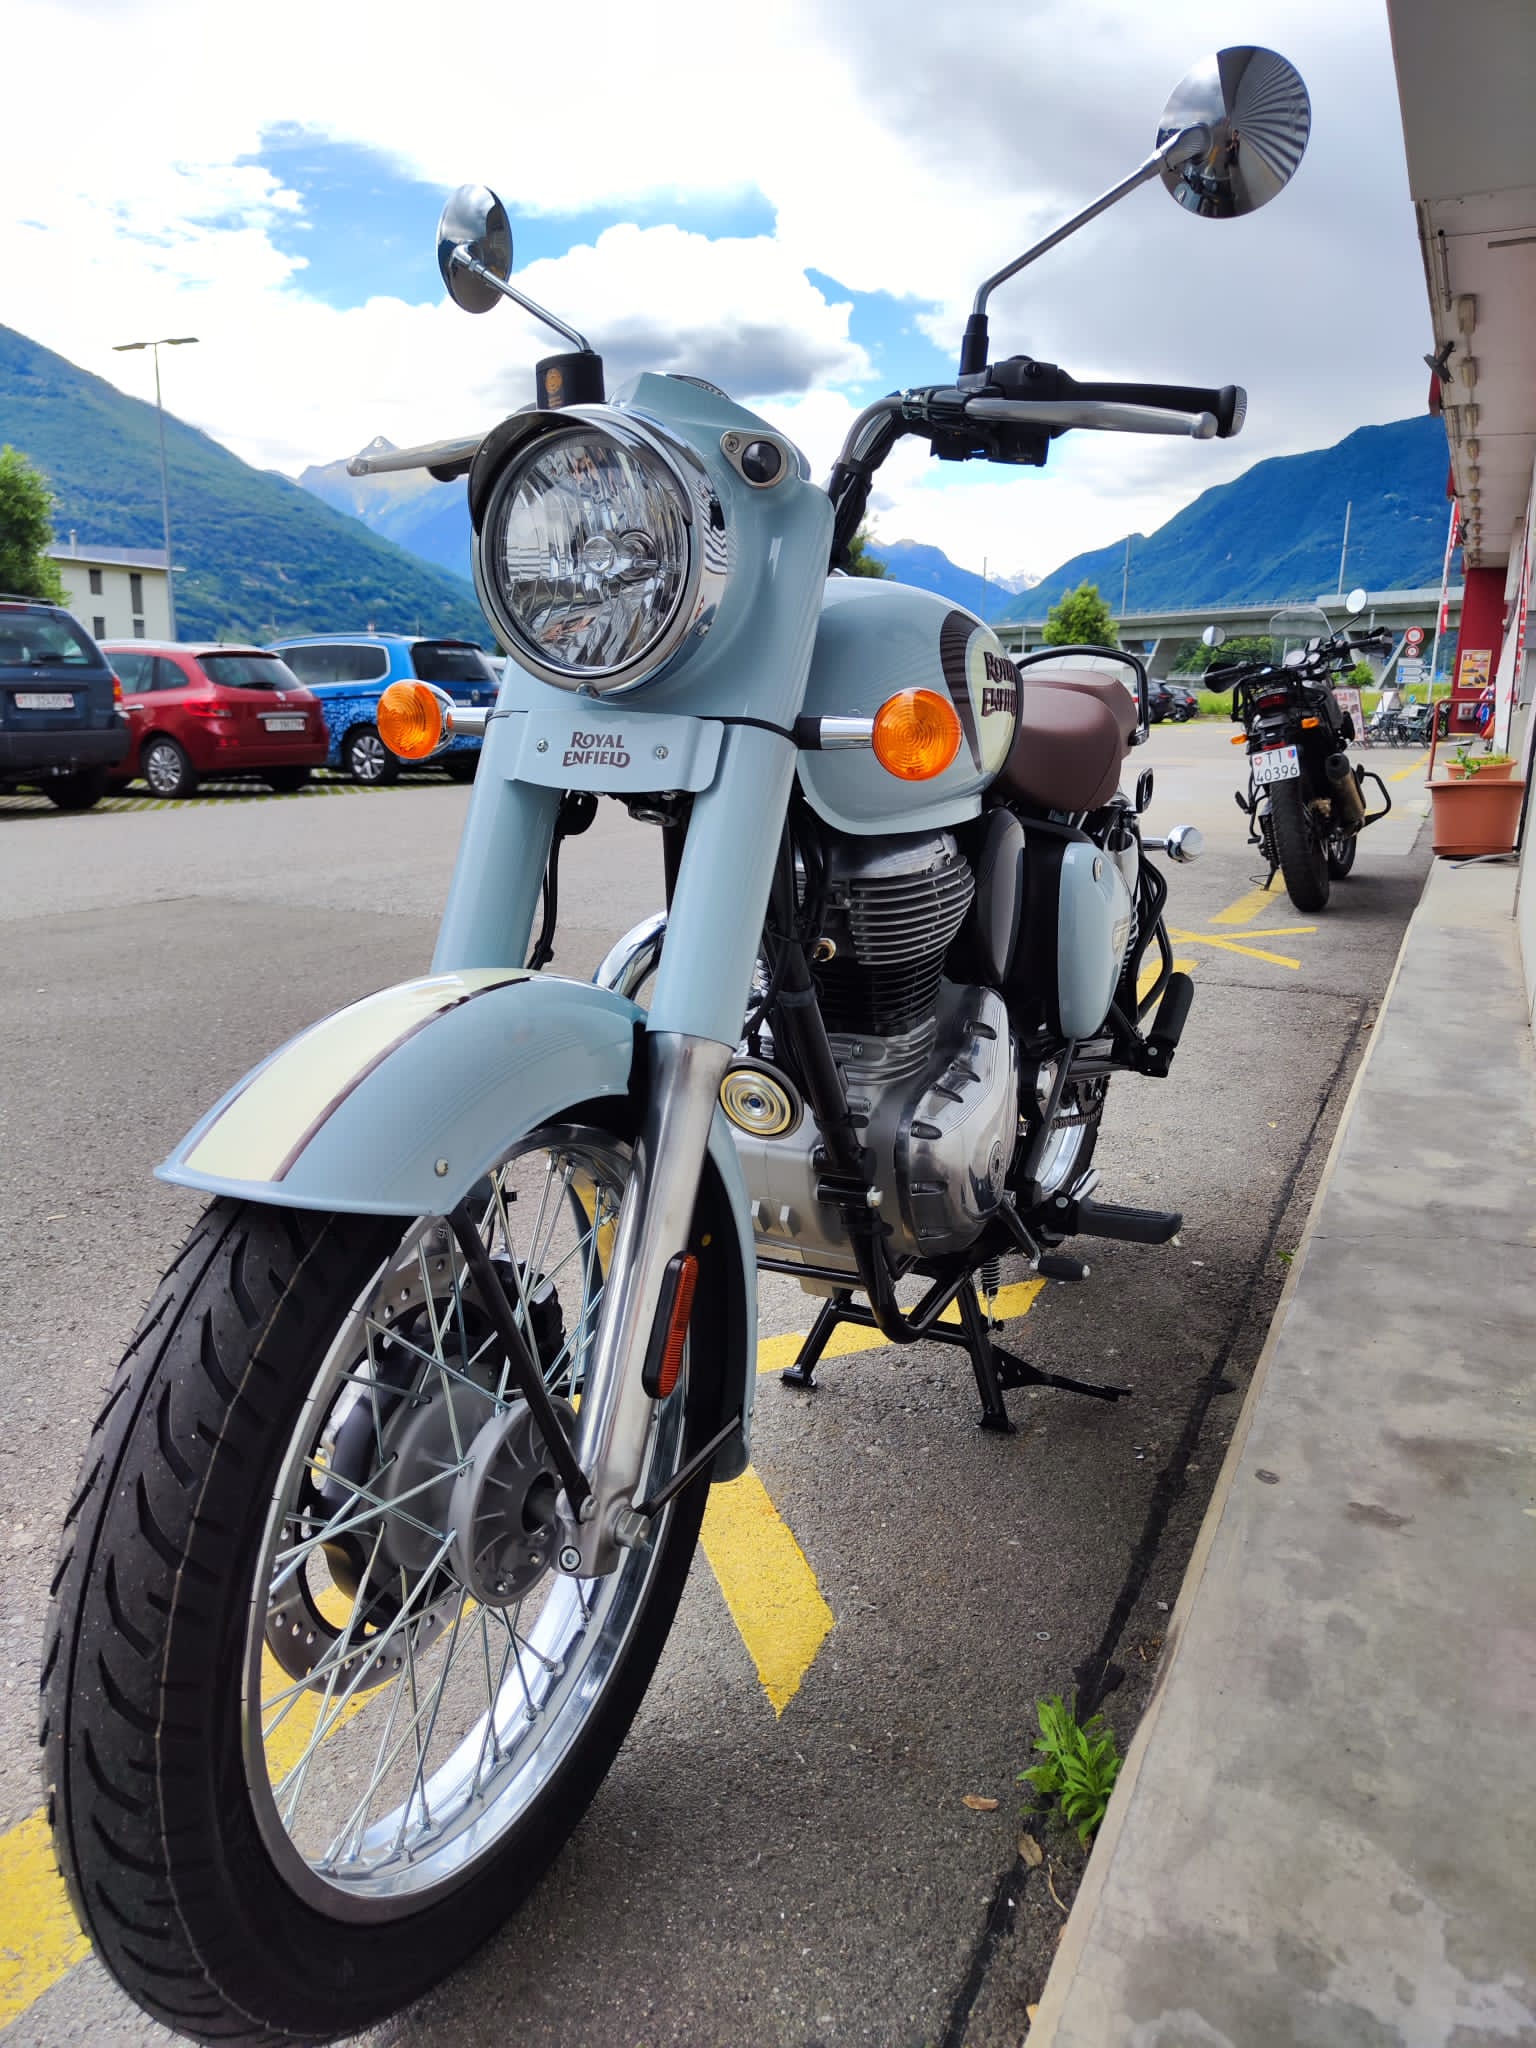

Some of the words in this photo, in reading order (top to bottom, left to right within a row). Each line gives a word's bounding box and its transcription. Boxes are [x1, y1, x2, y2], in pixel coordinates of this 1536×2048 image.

[571, 731, 625, 749] ROYAL
[562, 751, 631, 768] ENFIELD
[1266, 750, 1282, 766] TI
[1256, 763, 1298, 782] 40396
